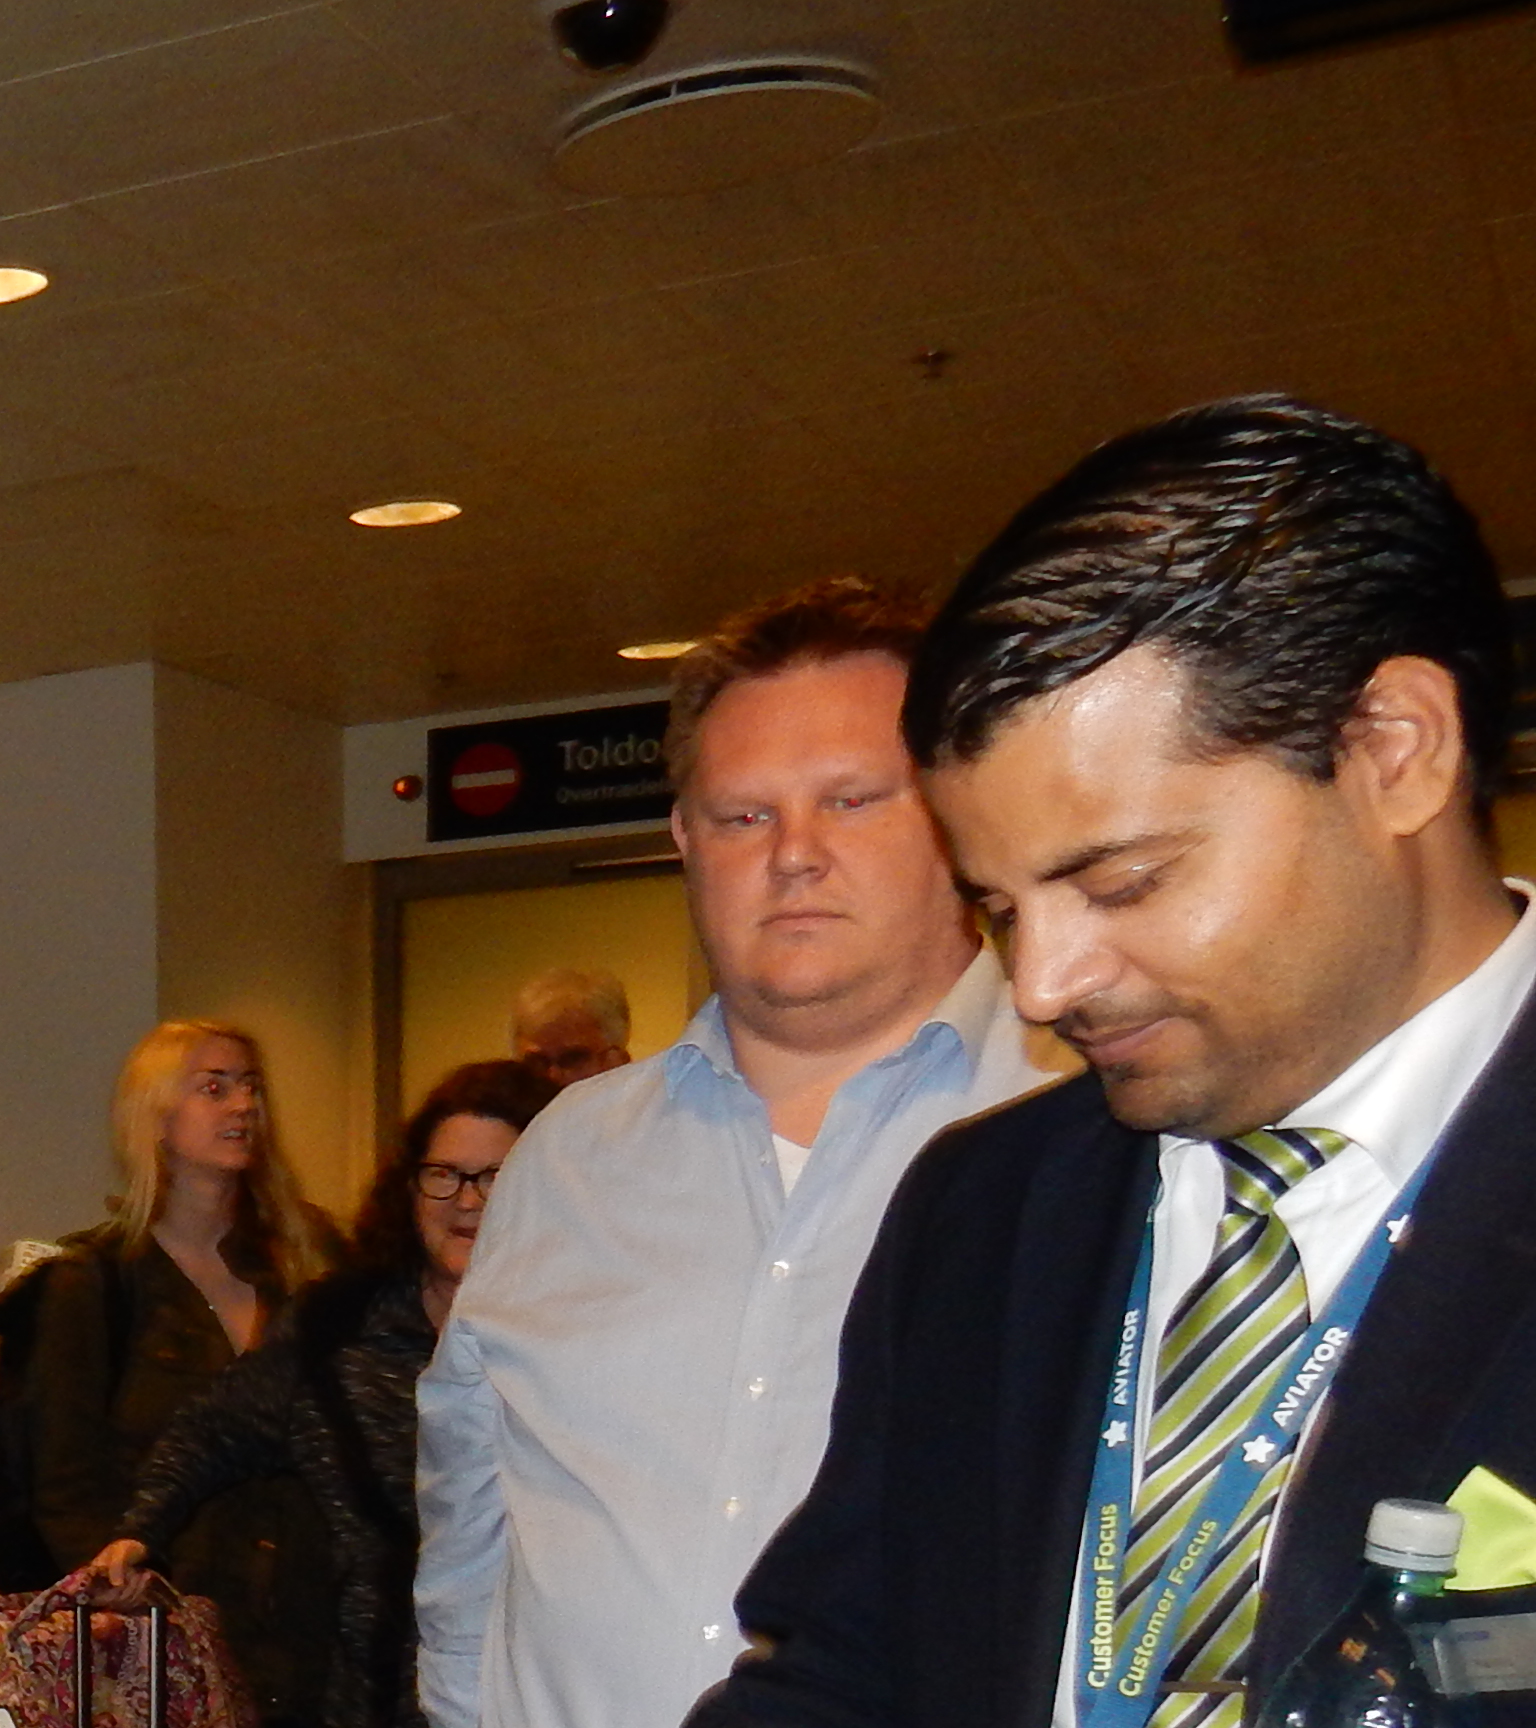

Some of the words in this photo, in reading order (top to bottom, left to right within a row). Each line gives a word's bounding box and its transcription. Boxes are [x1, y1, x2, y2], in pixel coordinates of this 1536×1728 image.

[557, 734, 660, 770] Toldo
[1112, 1309, 1140, 1406] AVIATOR
[1271, 1326, 1351, 1428] AVIATOR
[1093, 1502, 1119, 1572] Focus
[1086, 1575, 1115, 1689] Customer
[1118, 1586, 1177, 1698] Customer
[1167, 1519, 1218, 1586] Focus
